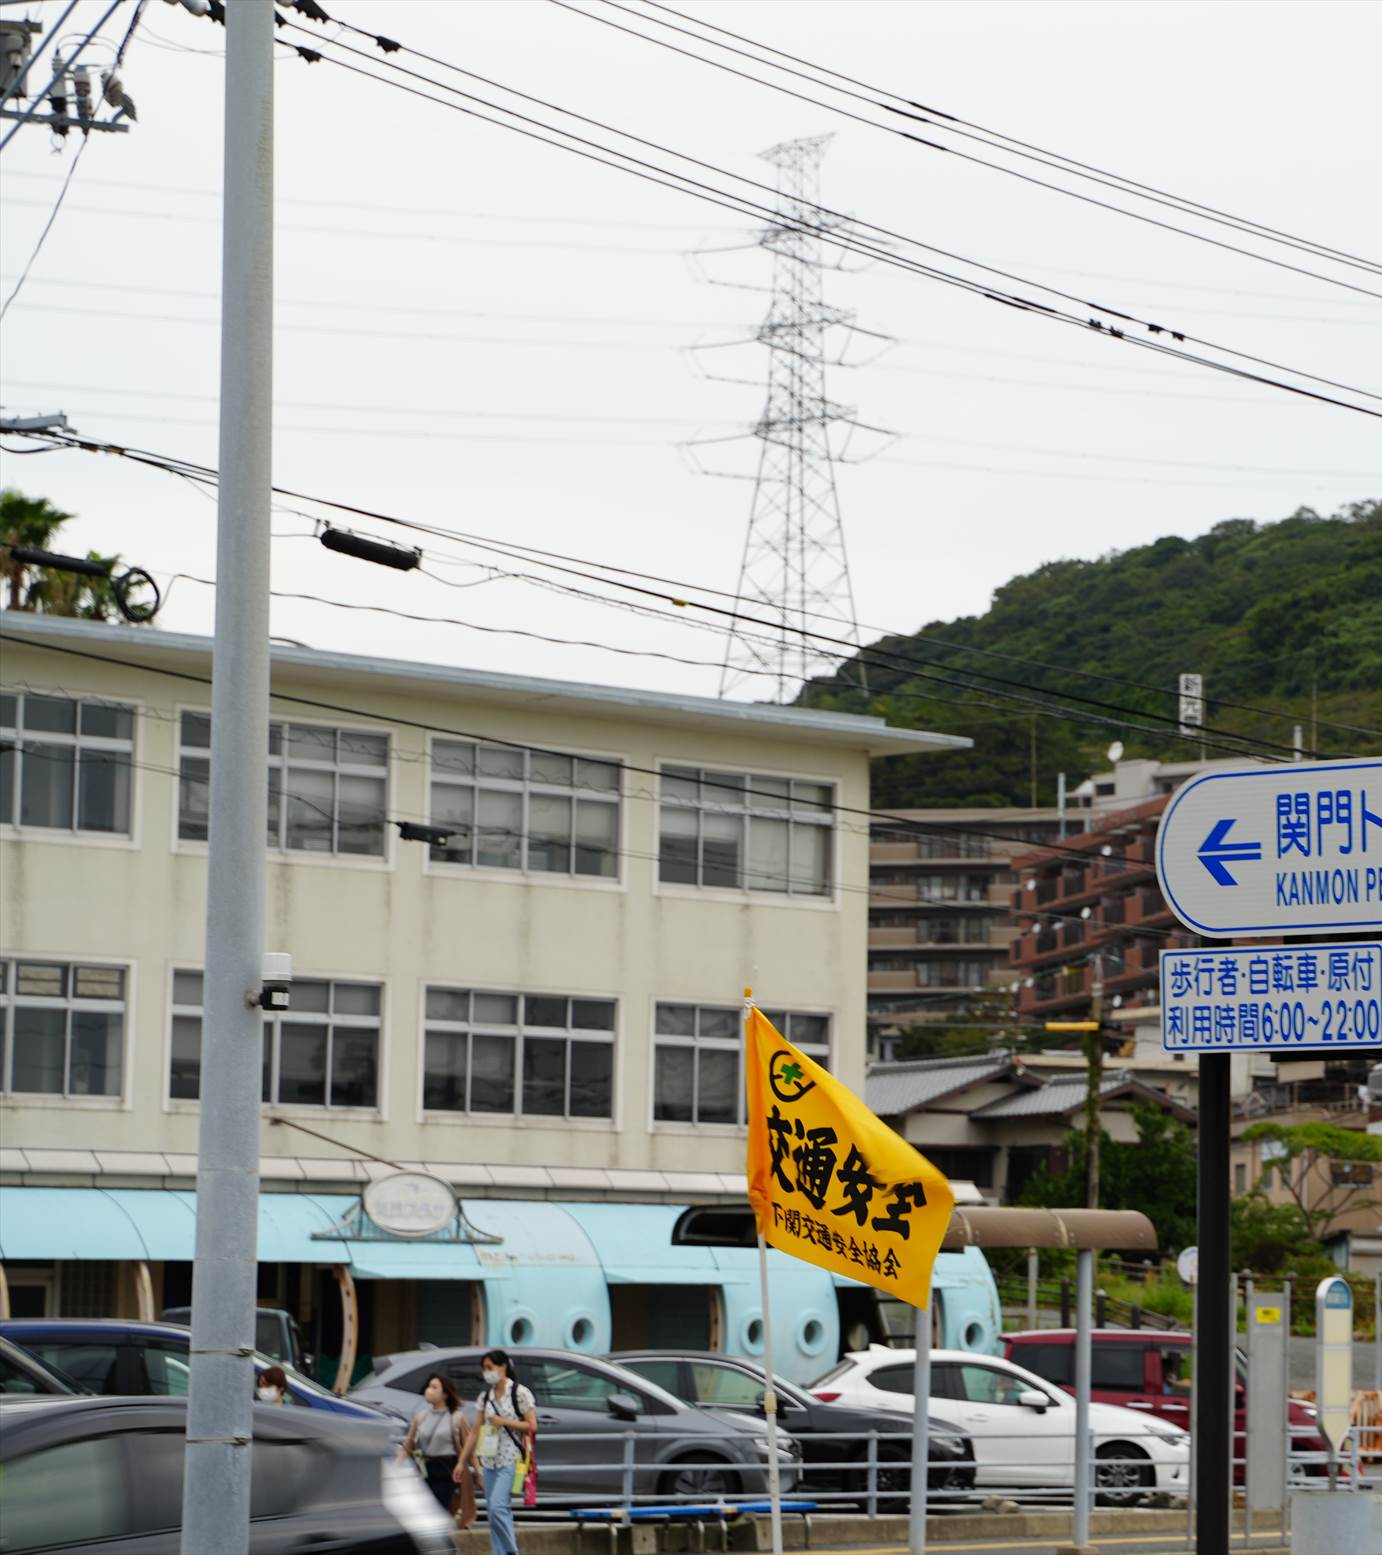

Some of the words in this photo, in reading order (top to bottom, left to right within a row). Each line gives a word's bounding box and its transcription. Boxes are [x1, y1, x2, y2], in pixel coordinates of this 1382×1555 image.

[1276, 868, 1359, 906] KANMON
[772, 1202, 901, 1279] 下関交通安全協会
